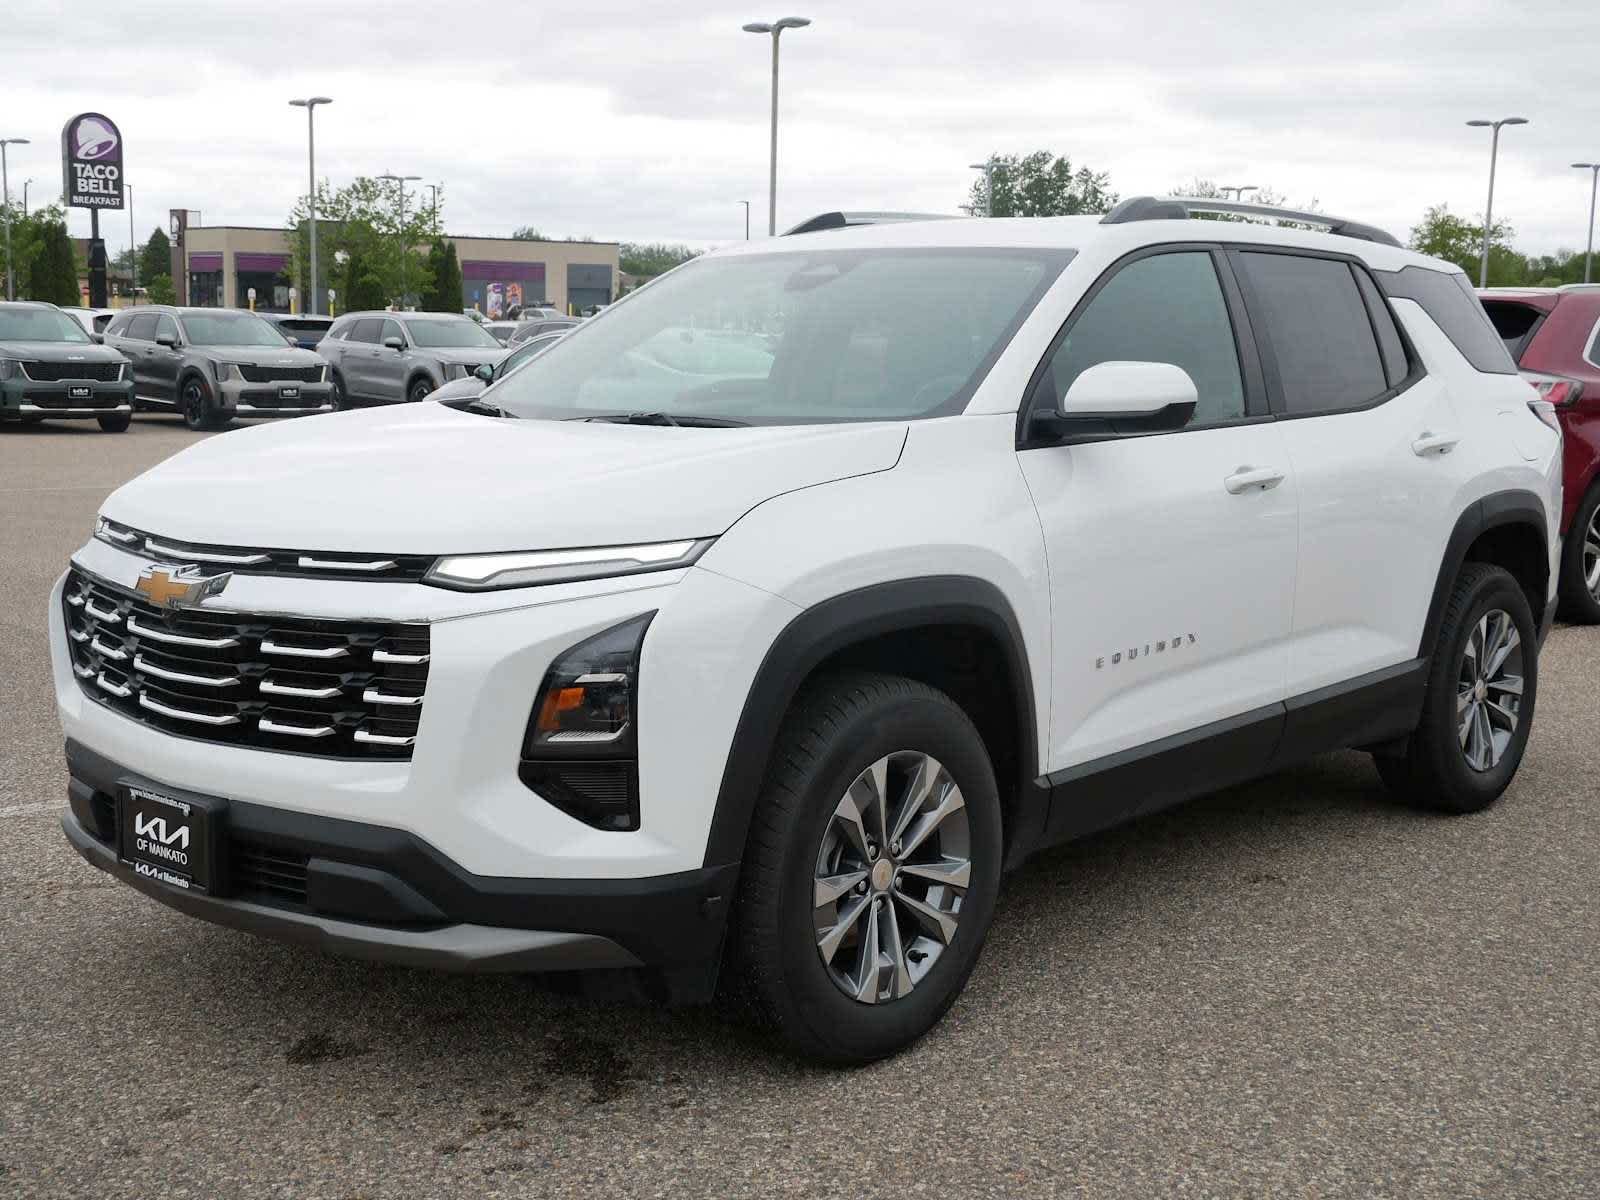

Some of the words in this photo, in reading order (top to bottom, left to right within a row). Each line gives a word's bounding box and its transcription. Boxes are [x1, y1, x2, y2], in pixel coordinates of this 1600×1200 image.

[73, 163, 118, 180] TACO
[77, 178, 118, 194] BELL
[72, 195, 120, 206] BREAKFAST
[1096, 633, 1198, 669] EQUINOX
[135, 811, 189, 850] KIA
[136, 838, 149, 851] OF
[148, 842, 188, 865] MANKATO
[135, 862, 158, 878] KIA
[163, 872, 189, 889] Mankato
